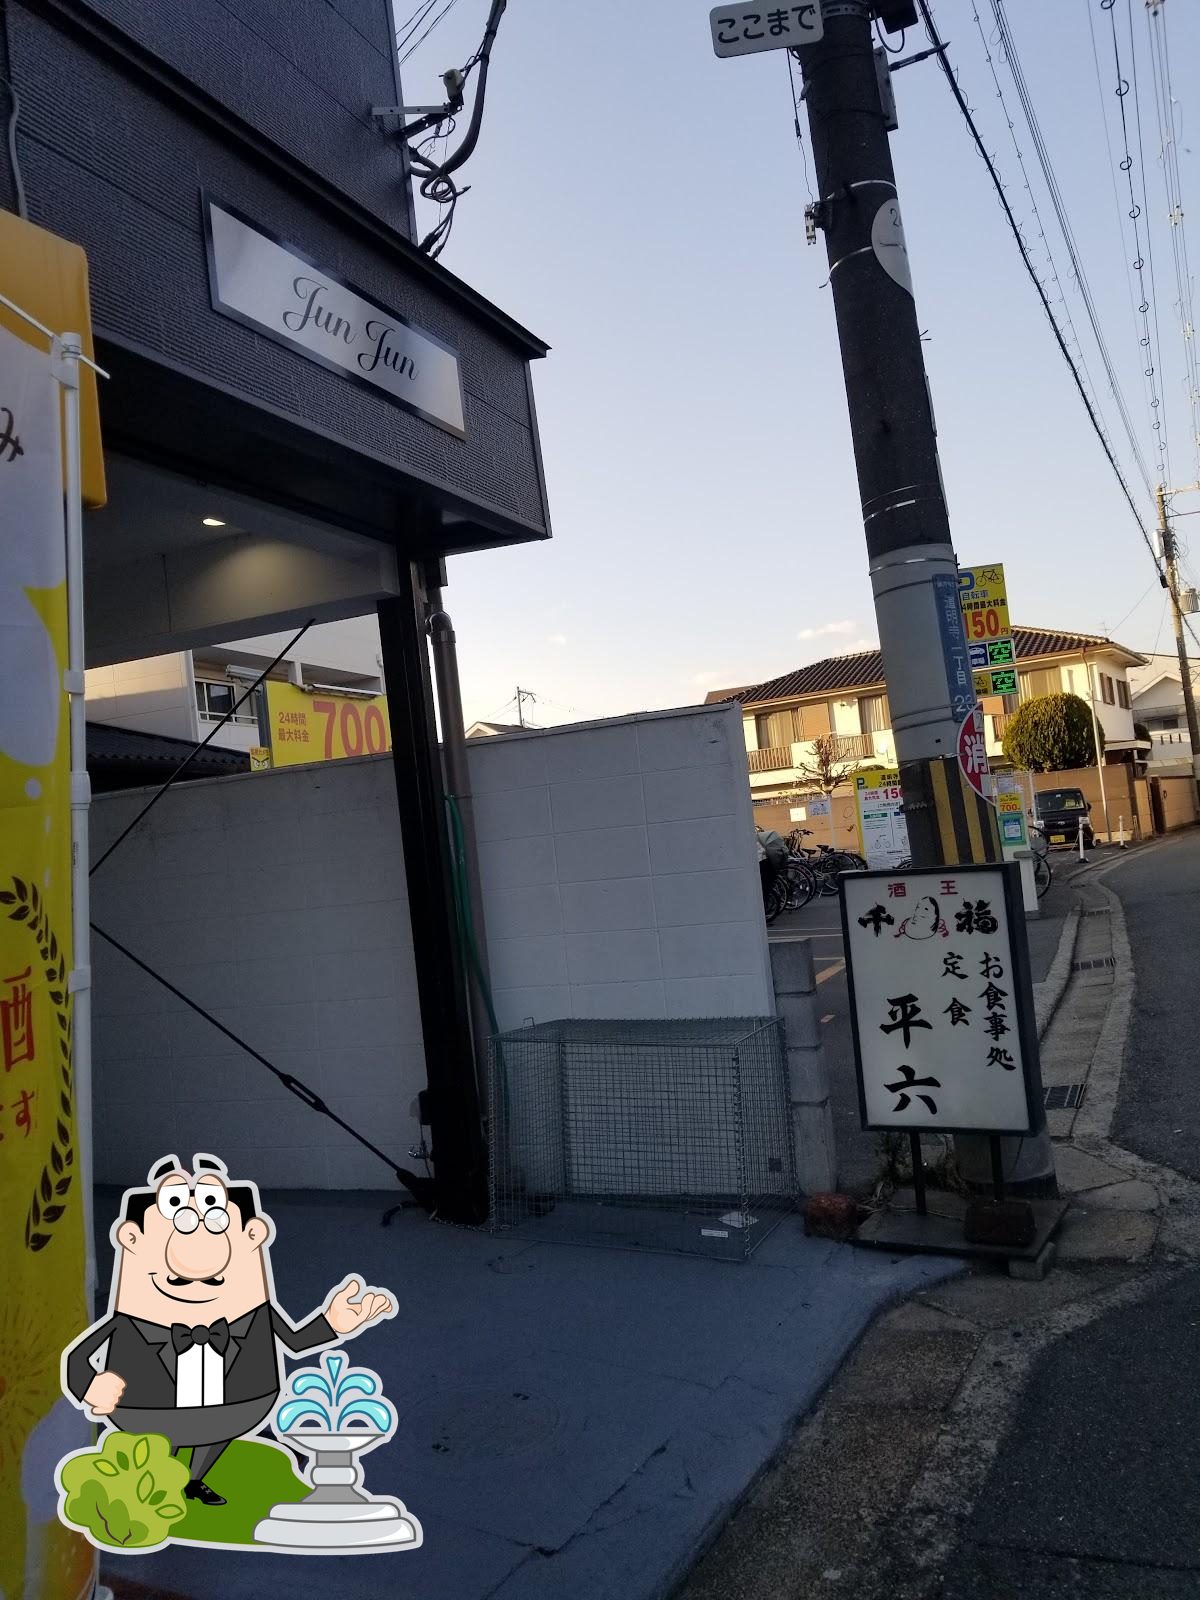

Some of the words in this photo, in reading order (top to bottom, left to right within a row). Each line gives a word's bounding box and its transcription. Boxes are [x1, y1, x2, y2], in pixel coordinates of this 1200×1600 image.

[717, 4, 817, 44] ここまで
[282, 276, 358, 345] Jun
[357, 320, 420, 382] Jun
[962, 589, 989, 601] 自転車
[988, 639, 1013, 666] 空
[992, 671, 1017, 695] 空
[278, 711, 307, 726] 24時間
[312, 700, 387, 761] 700
[278, 728, 310, 743] 最大料金
[978, 951, 1017, 1071] お食事処
